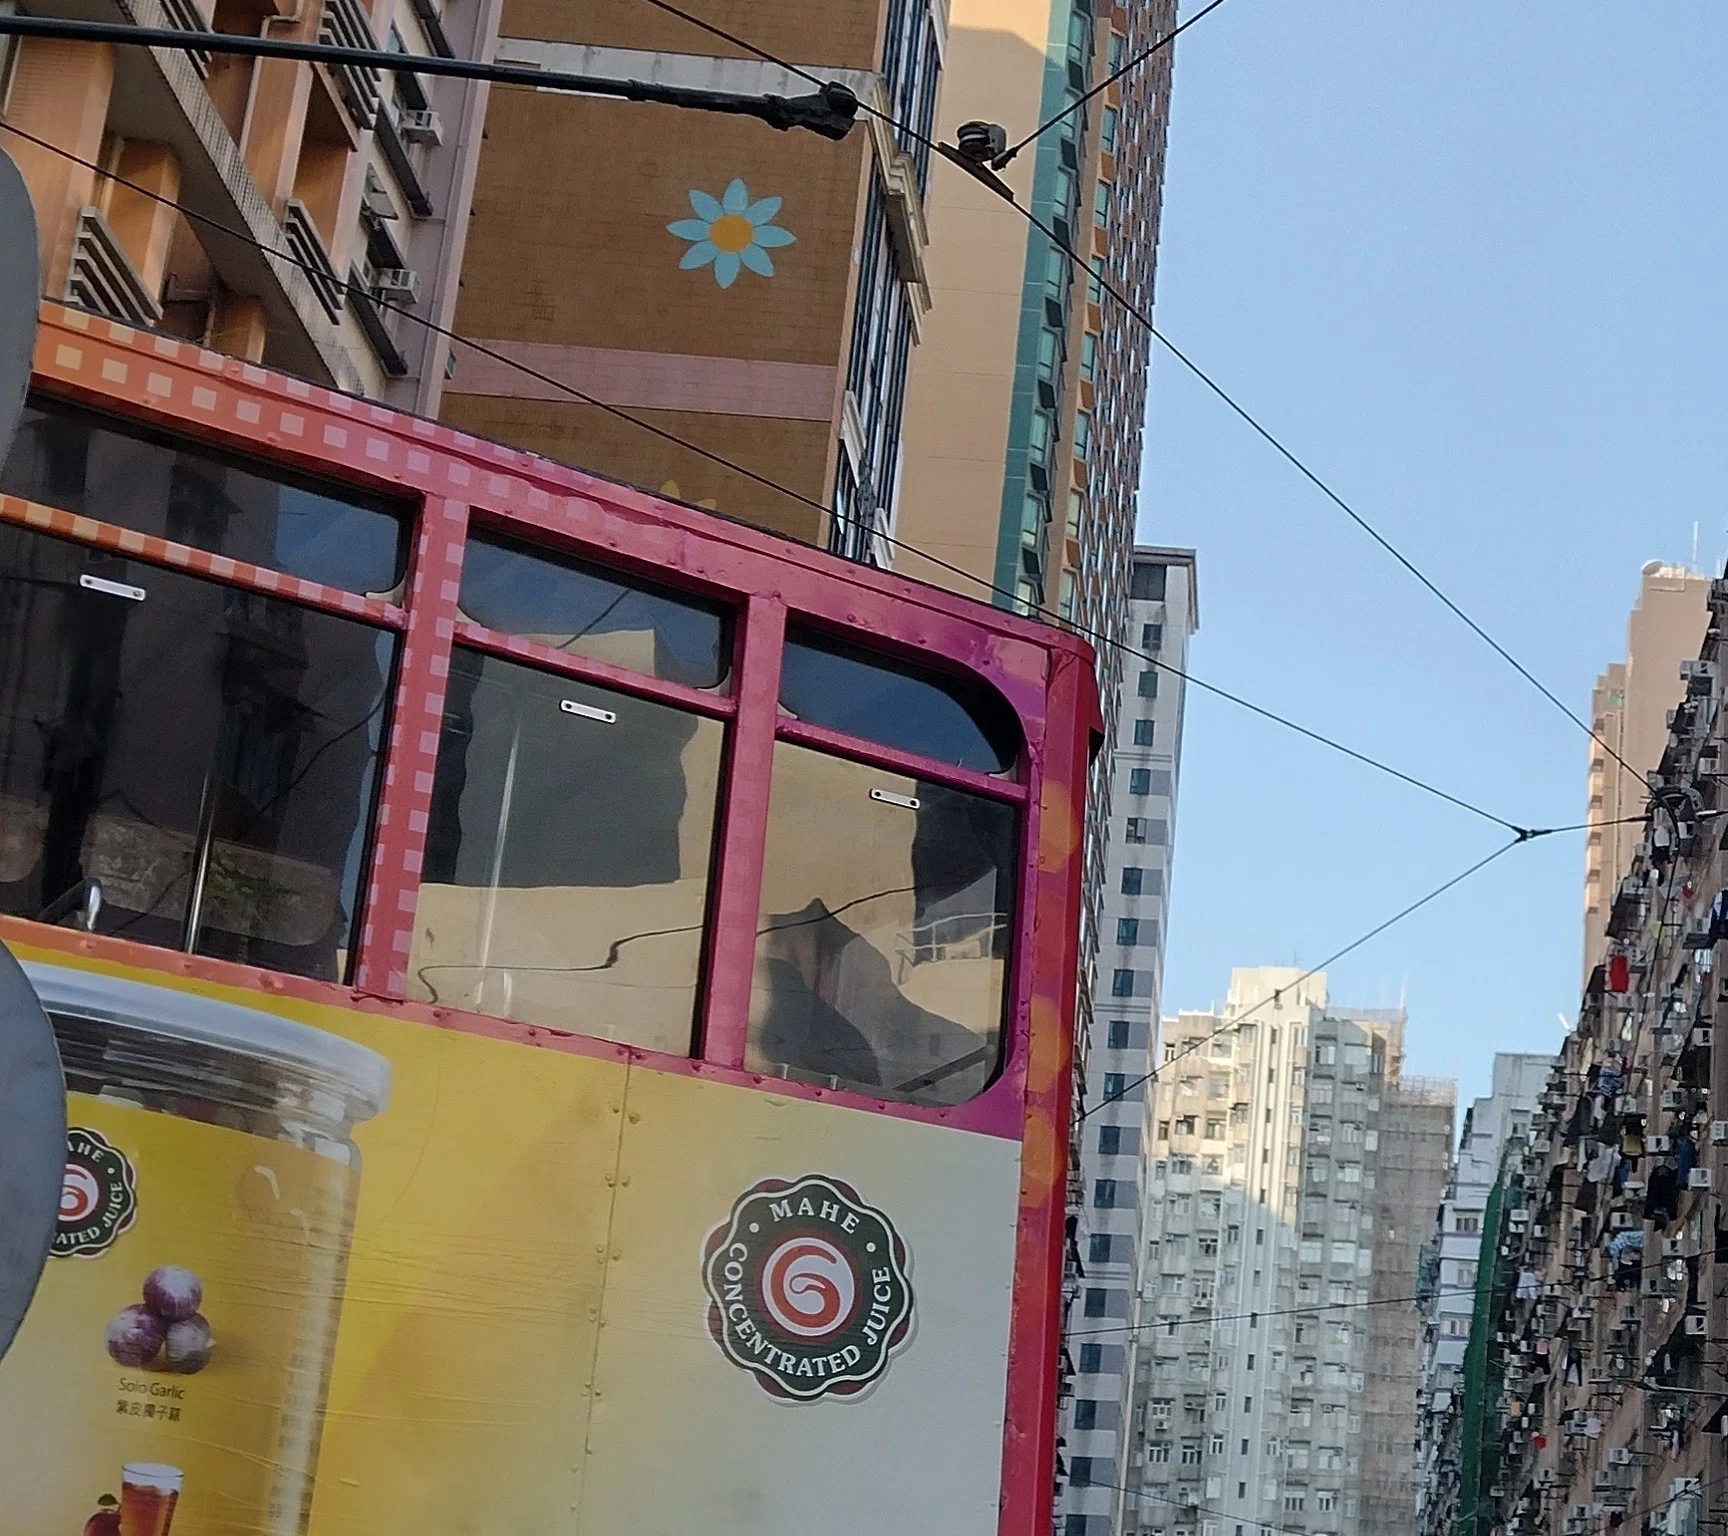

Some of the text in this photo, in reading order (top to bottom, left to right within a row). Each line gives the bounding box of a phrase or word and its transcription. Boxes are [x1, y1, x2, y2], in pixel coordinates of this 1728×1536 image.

[104, 1181, 124, 1228] JUICE
[768, 1197, 860, 1234] MAHE
[724, 1242, 892, 1377] CONCENTRATED JUICE
[118, 1377, 185, 1400] Solo Garlic
